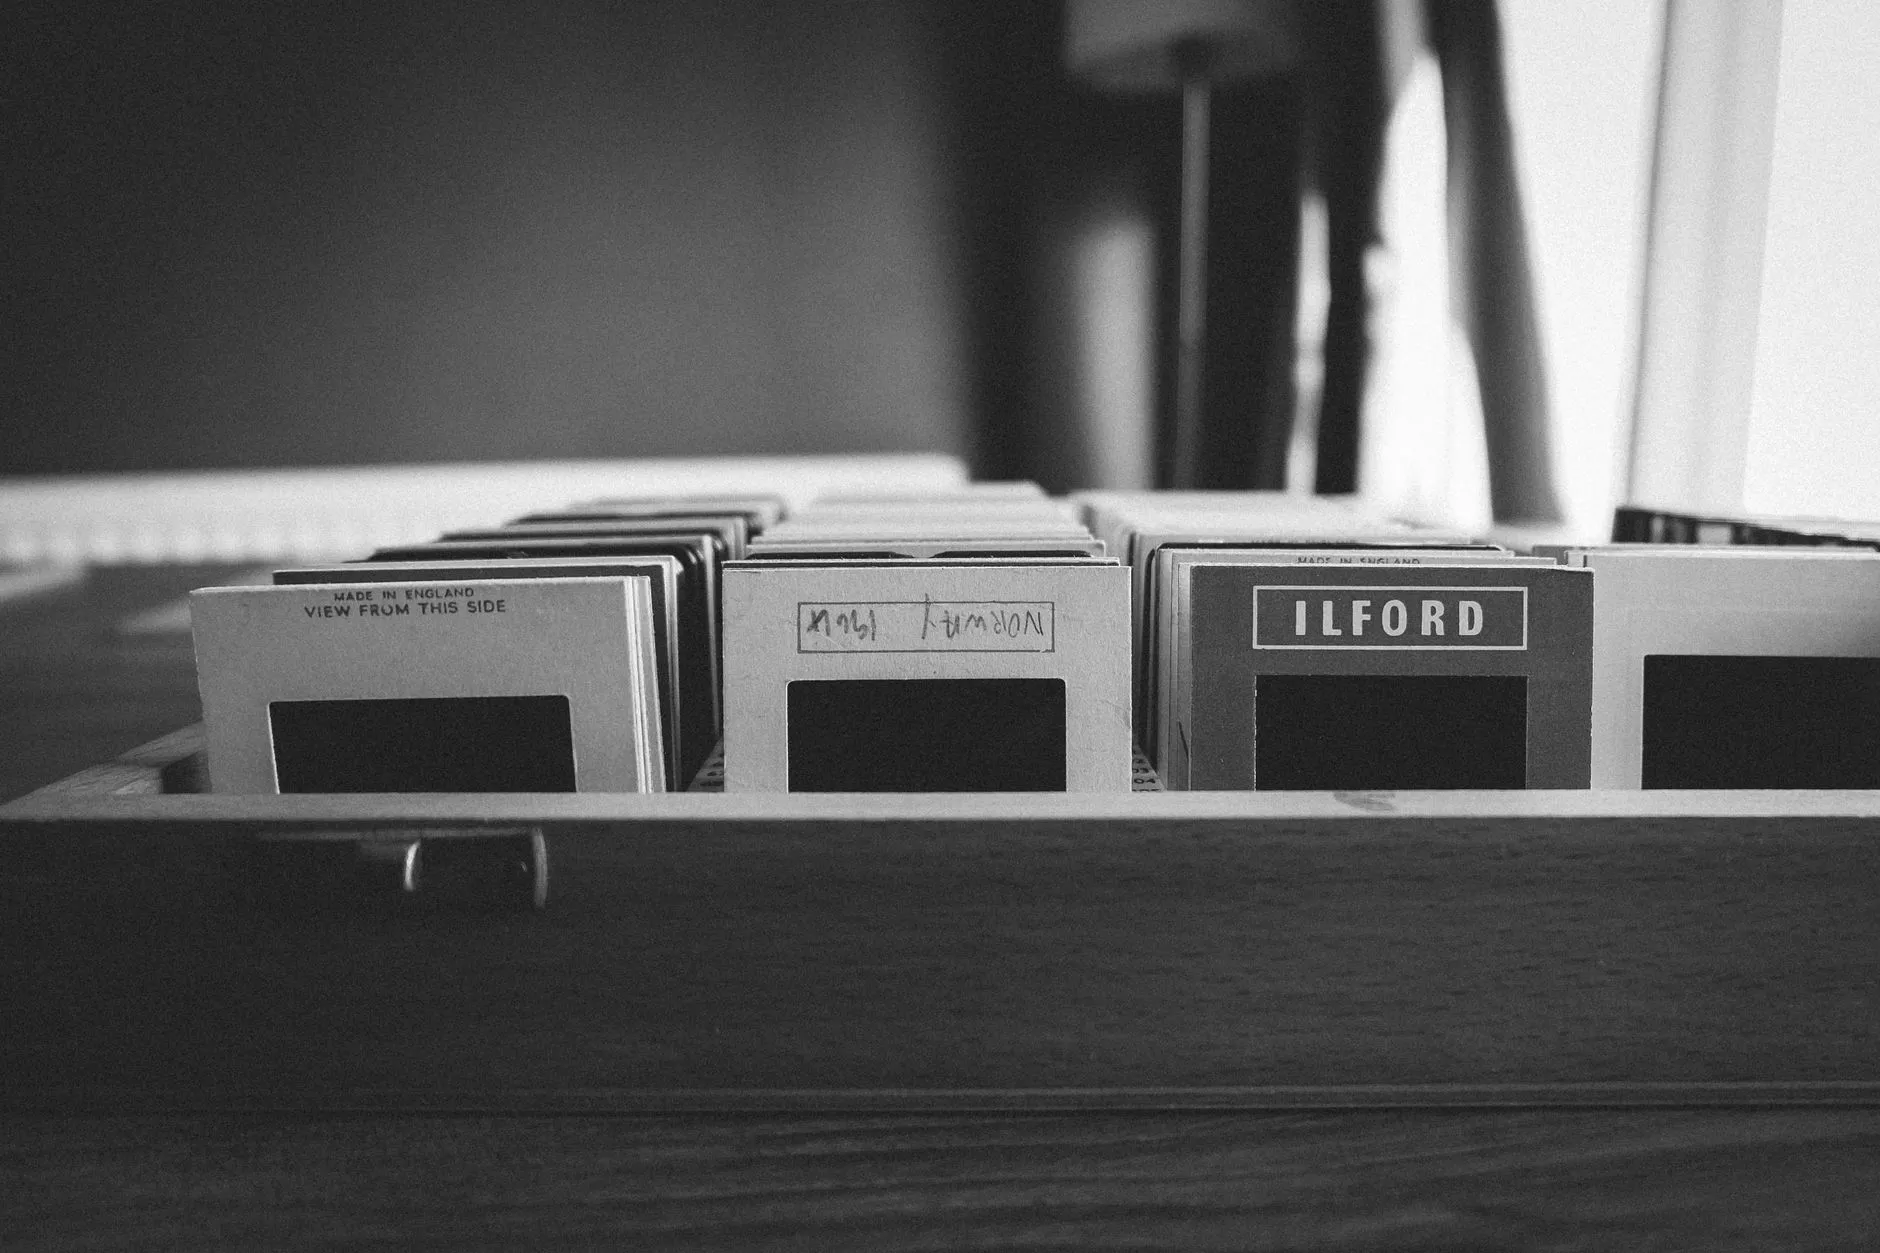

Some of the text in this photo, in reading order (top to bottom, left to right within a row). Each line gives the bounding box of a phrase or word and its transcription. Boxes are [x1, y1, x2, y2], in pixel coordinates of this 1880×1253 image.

[334, 587, 474, 601] MADE IN ENGLAND
[304, 599, 507, 618] VIEW FROM THIS SIDE
[921, 593, 1044, 639] NORWAY
[1295, 599, 1484, 637] ILFORD
